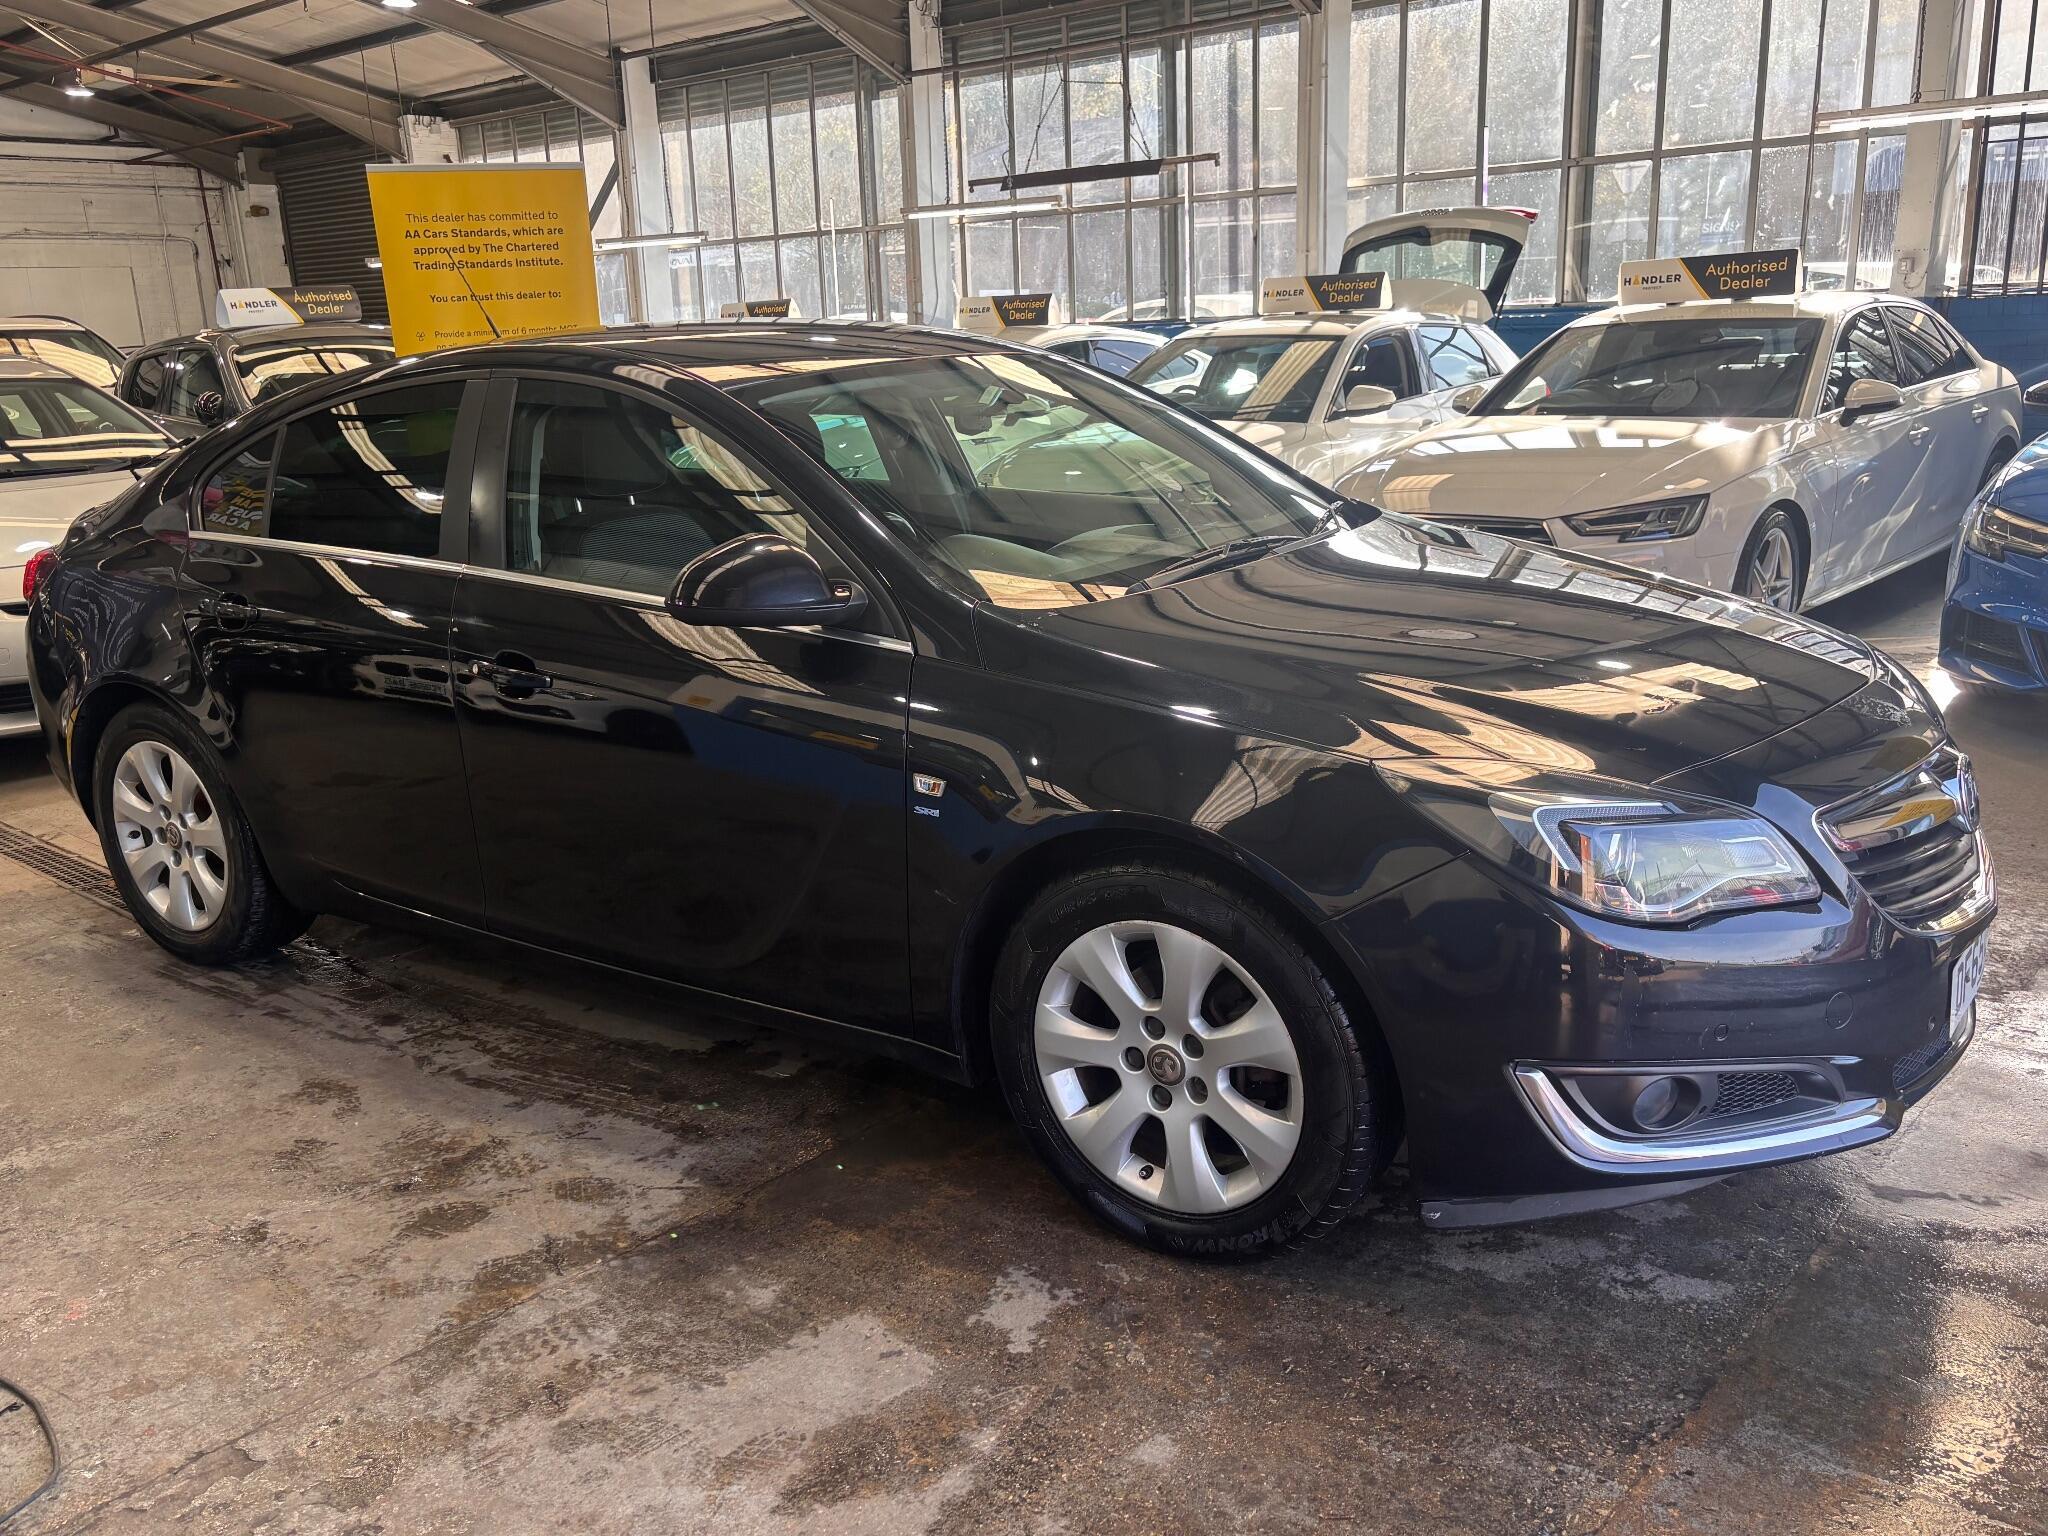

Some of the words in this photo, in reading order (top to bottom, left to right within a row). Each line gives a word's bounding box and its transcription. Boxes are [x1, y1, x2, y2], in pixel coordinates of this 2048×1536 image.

[405, 213, 429, 223] This
[432, 212, 465, 222] dealer
[467, 212, 486, 221] has
[489, 210, 545, 221] committed
[547, 210, 559, 220] to
[405, 229, 421, 239] AA
[423, 229, 448, 238] Cars
[451, 227, 511, 238] Standards,
[512, 226, 545, 236] which
[547, 226, 564, 235] are
[413, 244, 465, 256] approved
[468, 244, 480, 255] by
[482, 243, 504, 253] The
[506, 241, 560, 252] Chartered
[413, 260, 455, 272] Trading
[457, 259, 513, 269] Standards
[515, 257, 564, 267] Institute.
[1705, 257, 1789, 277] Authorised
[1320, 278, 1378, 292] Authorised
[1623, 273, 1682, 287] HANDLER
[1719, 275, 1772, 291] Dealer
[294, 290, 353, 303] Authorised
[430, 294, 448, 303] You
[450, 294, 467, 302] can
[468, 293, 494, 302] trust
[495, 291, 514, 301] this
[516, 290, 546, 300] dealer
[548, 290, 561, 299] to:
[1263, 288, 1305, 298] HANDLER
[1329, 291, 1365, 303] Dealer
[230, 300, 278, 310] HANDLER
[307, 303, 345, 315] Dealer
[754, 304, 787, 314] Authorised
[1002, 298, 1047, 310] Authorised
[1009, 309, 1037, 320] Dealer
[434, 330, 465, 339] Provide
[511, 326, 519, 335] of
[521, 327, 527, 335] 6
